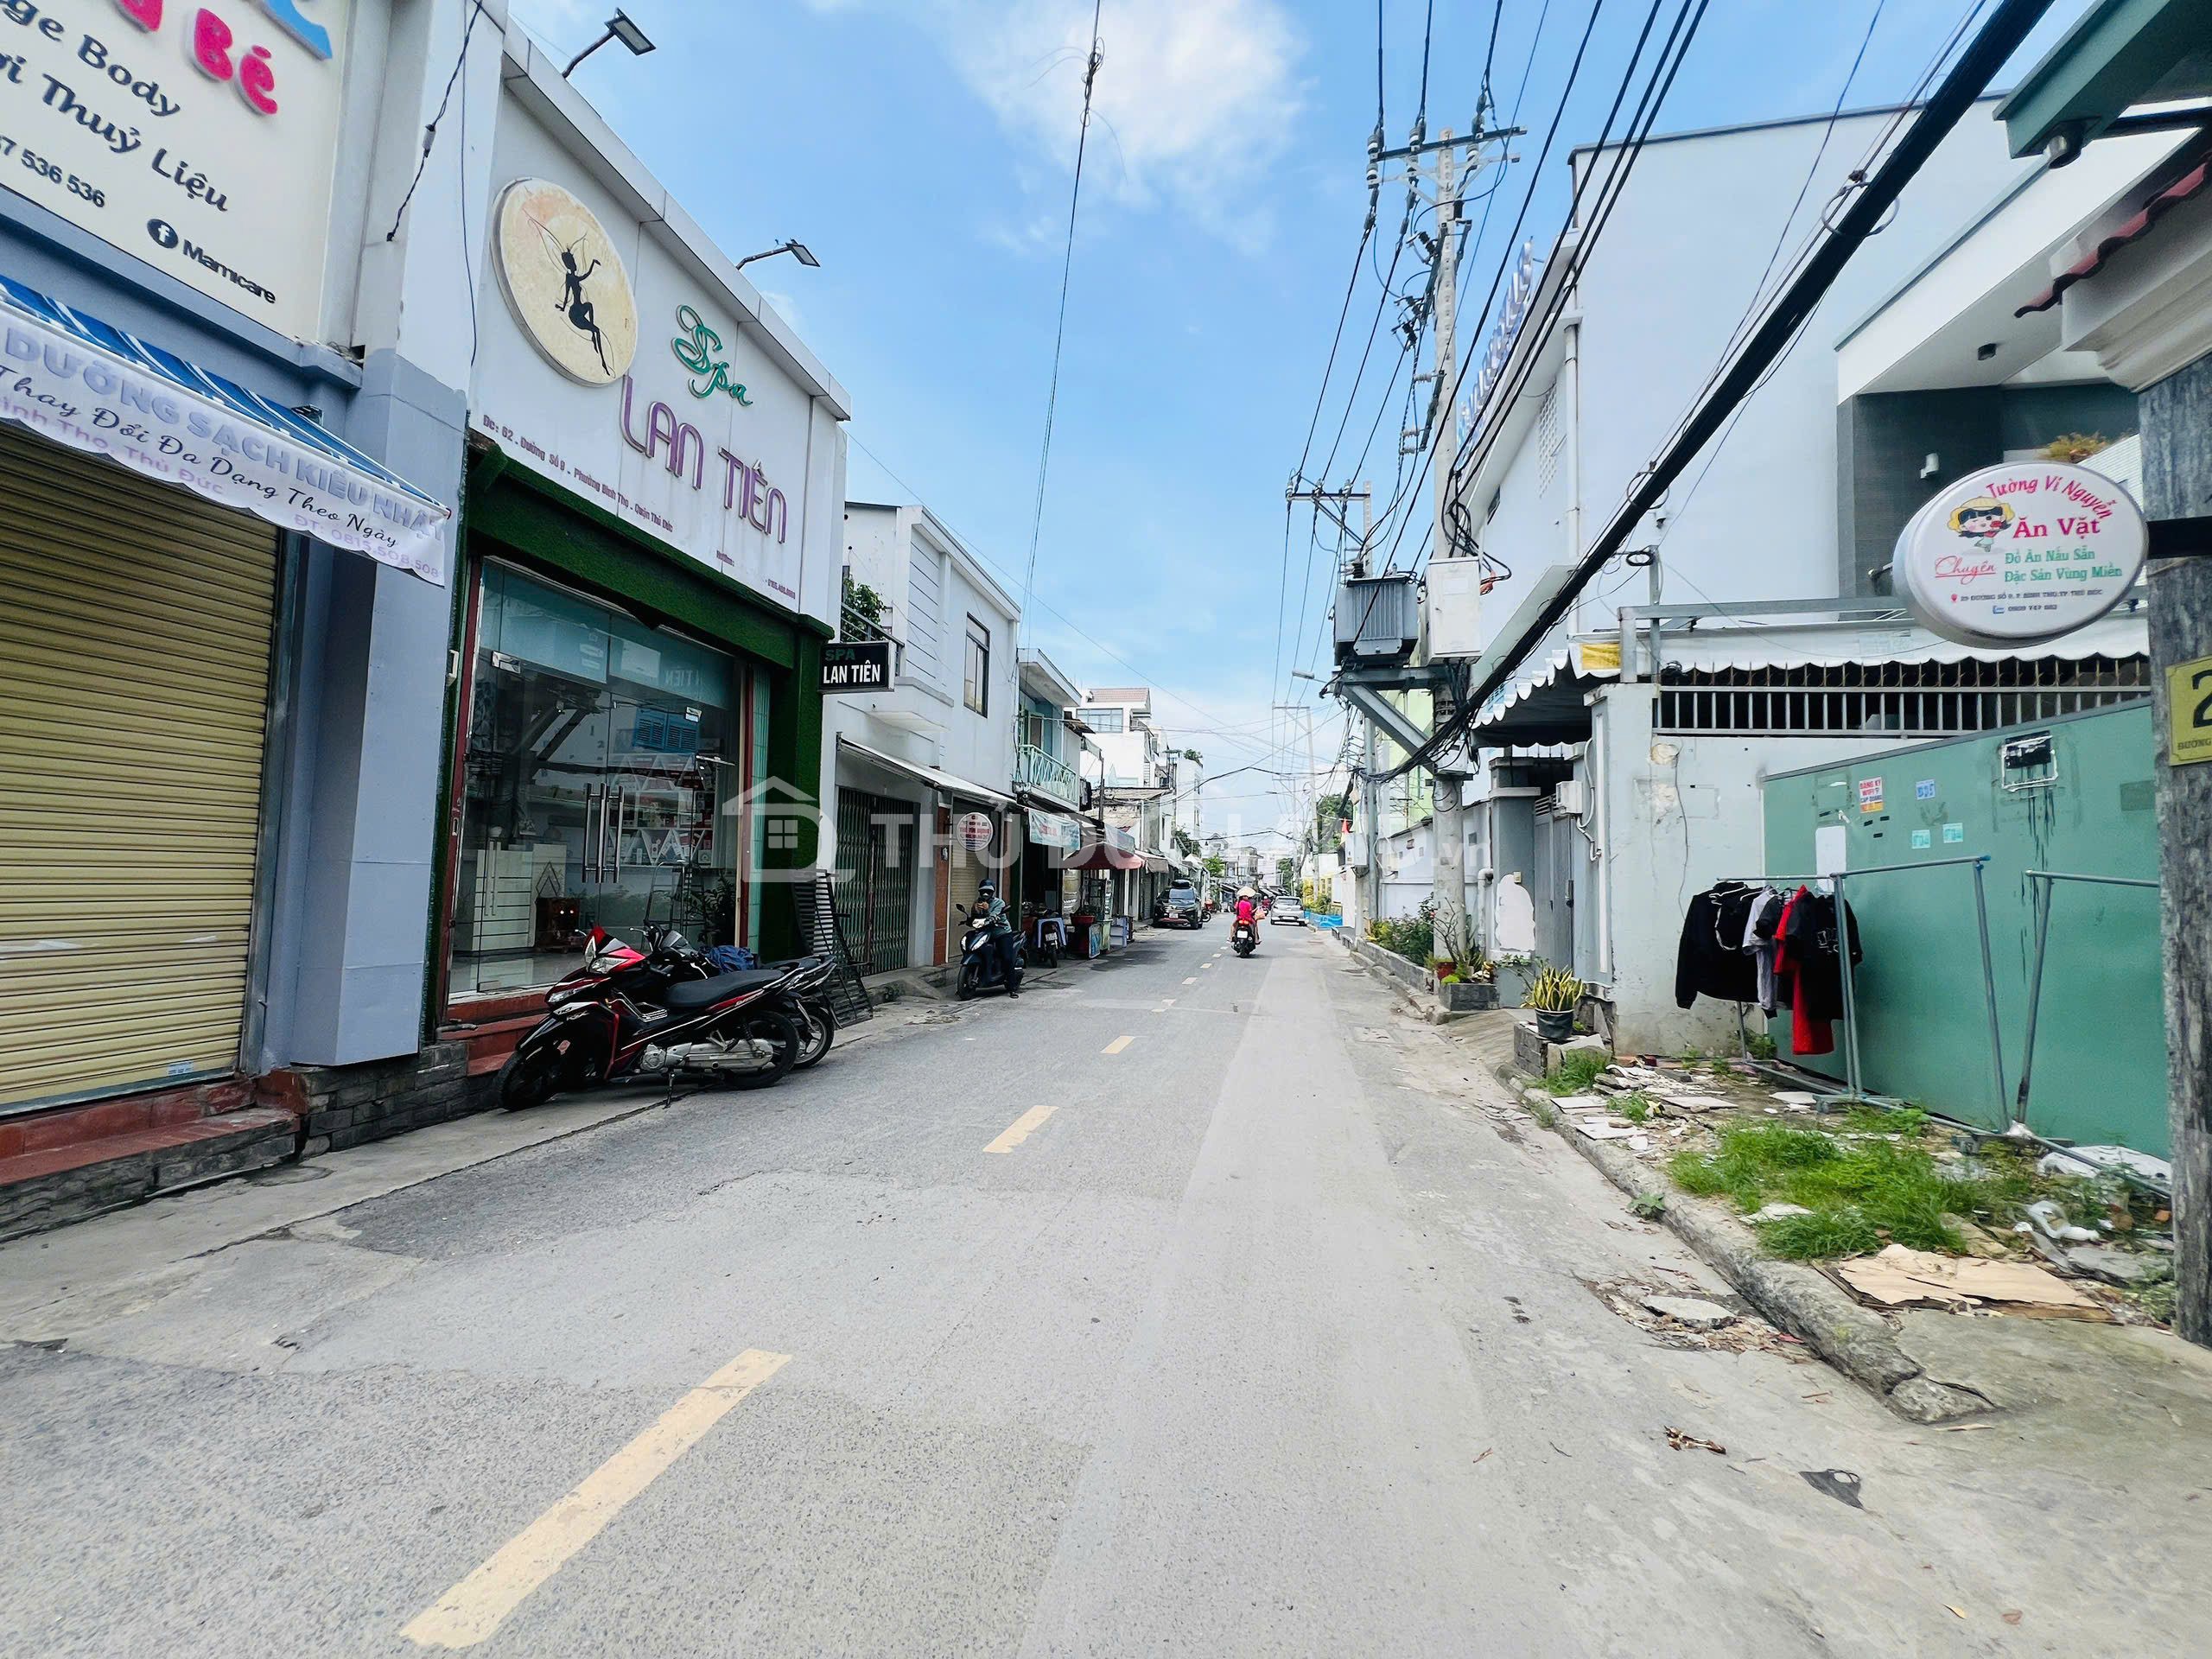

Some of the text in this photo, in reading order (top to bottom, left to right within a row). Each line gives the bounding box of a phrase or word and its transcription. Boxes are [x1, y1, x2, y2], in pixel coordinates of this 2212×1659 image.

[0, 0, 64, 41] ge
[78, 35, 180, 117] Body
[192, 8, 277, 115] Bé
[0, 136, 105, 208] 7 536 536
[42, 73, 141, 153] Thuỷ
[151, 148, 228, 212] Liệu
[182, 238, 276, 304] Mamicare
[671, 305, 753, 406] Spa
[5, 327, 180, 425] DƯỠNG
[187, 411, 290, 474] SẠCH
[502, 426, 514, 442] 62
[0, 365, 397, 547] Thay Đổi Đa Dạng Theo Ngày
[620, 373, 787, 544] LAN TIÊN
[1986, 478, 2038, 499] Tường
[2062, 480, 2117, 520] Nguyễn
[2012, 517, 2101, 539] Ăn Vặt
[1935, 556, 1997, 585] Chuyên
[823, 659, 880, 683] LAN TIÊN
[825, 649, 855, 662] SPA
